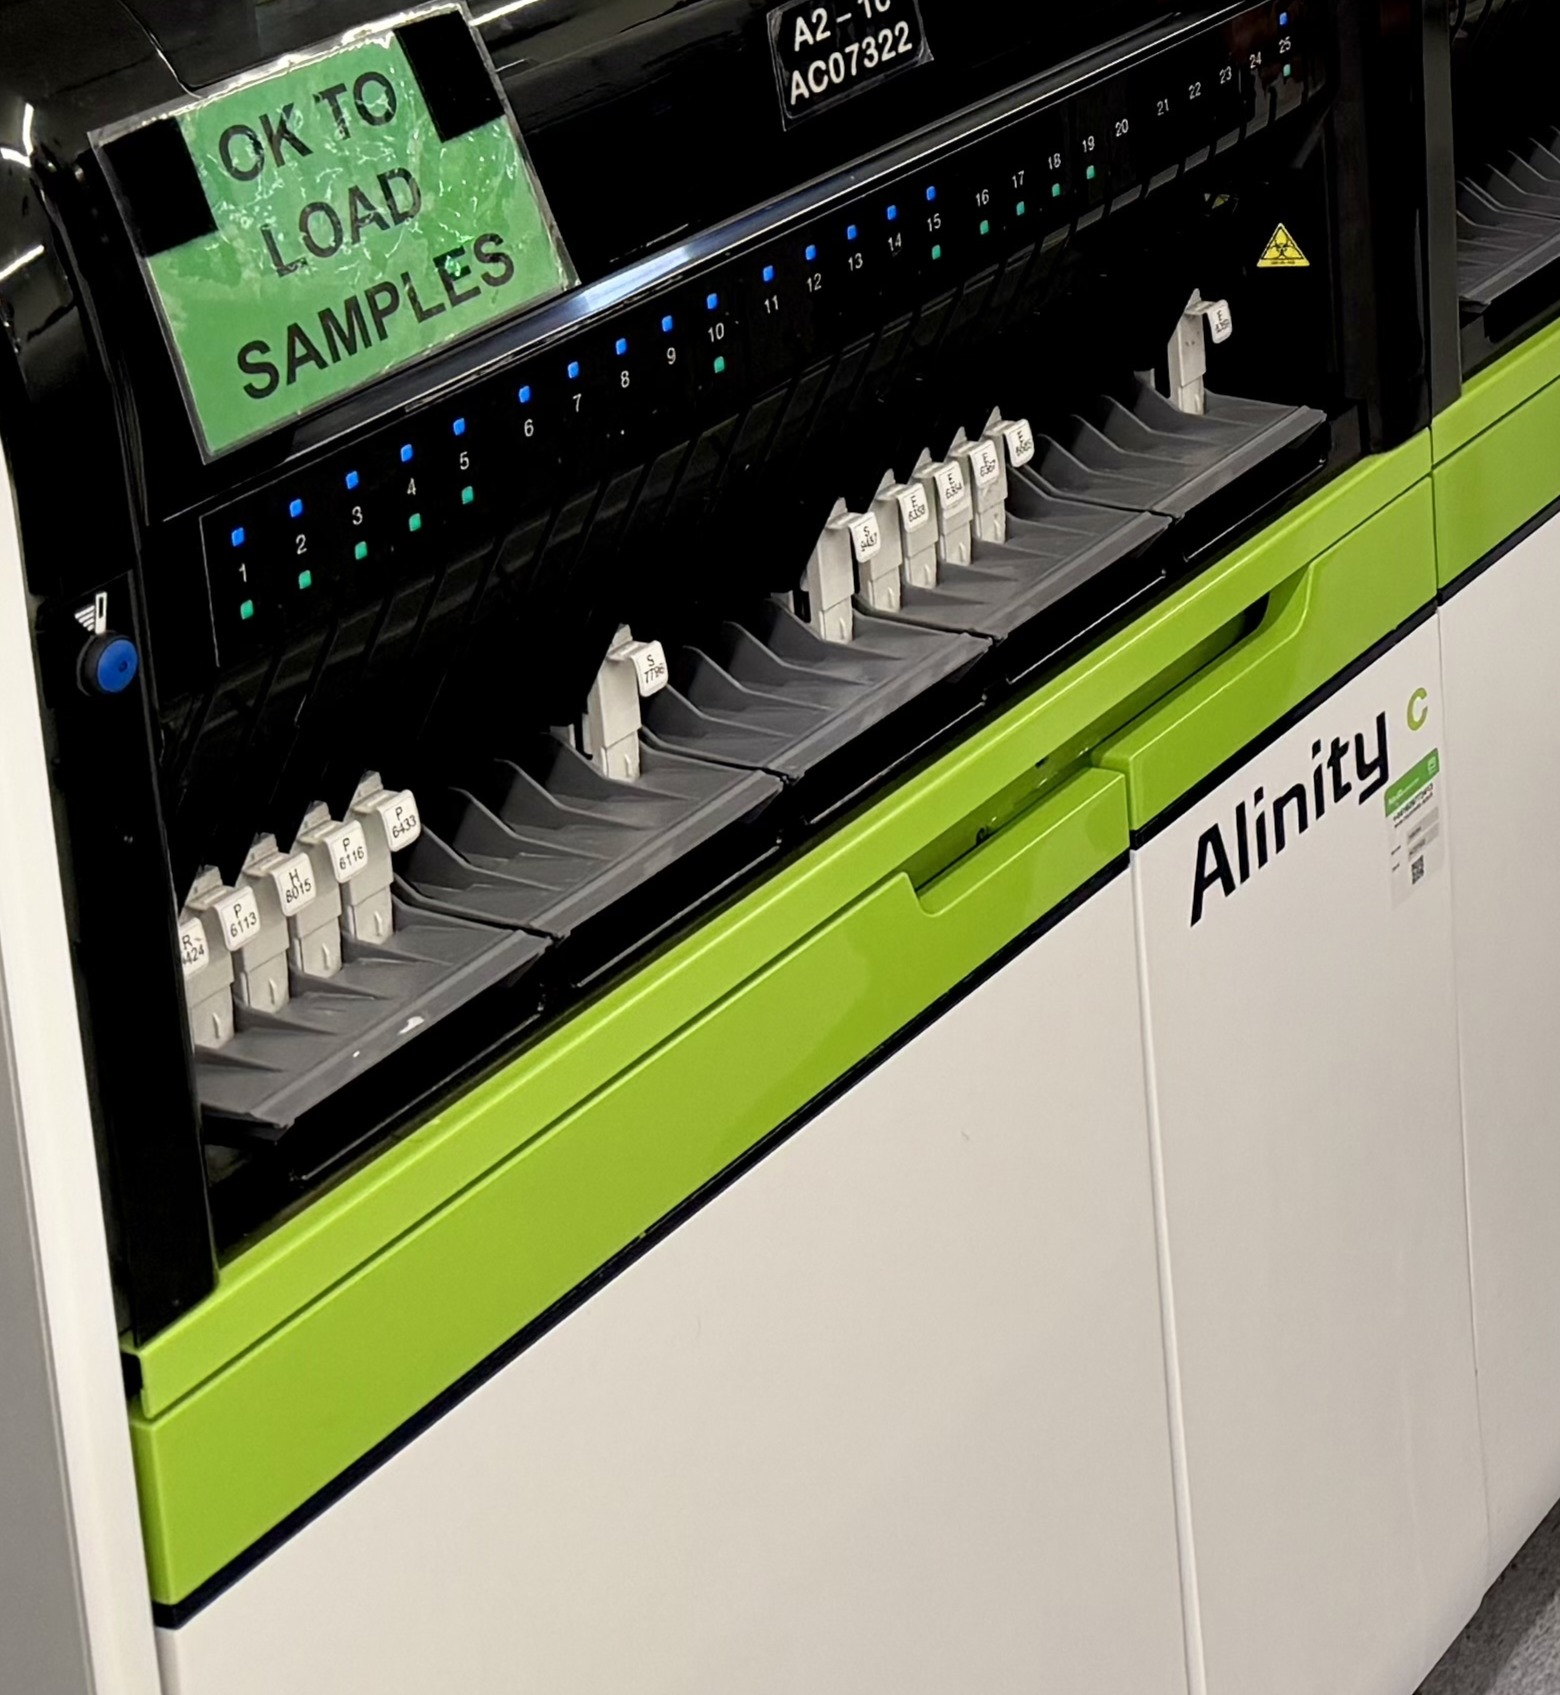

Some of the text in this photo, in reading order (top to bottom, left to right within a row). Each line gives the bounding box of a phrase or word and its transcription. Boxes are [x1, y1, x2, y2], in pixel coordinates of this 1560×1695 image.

[790, 21, 913, 105] AC07322
[219, 71, 397, 181] OK TO
[260, 167, 422, 277] LOAD
[237, 233, 514, 399] SAMPLES
[239, 36, 1291, 583] 1 2 3 4 5 6 7 8 9 10 11 12 13 14 15 16 17 18 19 20 21 22 23 24 25
[646, 654, 655, 667] S
[394, 806, 403, 821] P
[1190, 710, 1389, 928] Alinity
[342, 837, 350, 852] P
[289, 868, 300, 887] H
[233, 903, 242, 918] P
[230, 913, 258, 938] 6113
[182, 934, 192, 950] R
